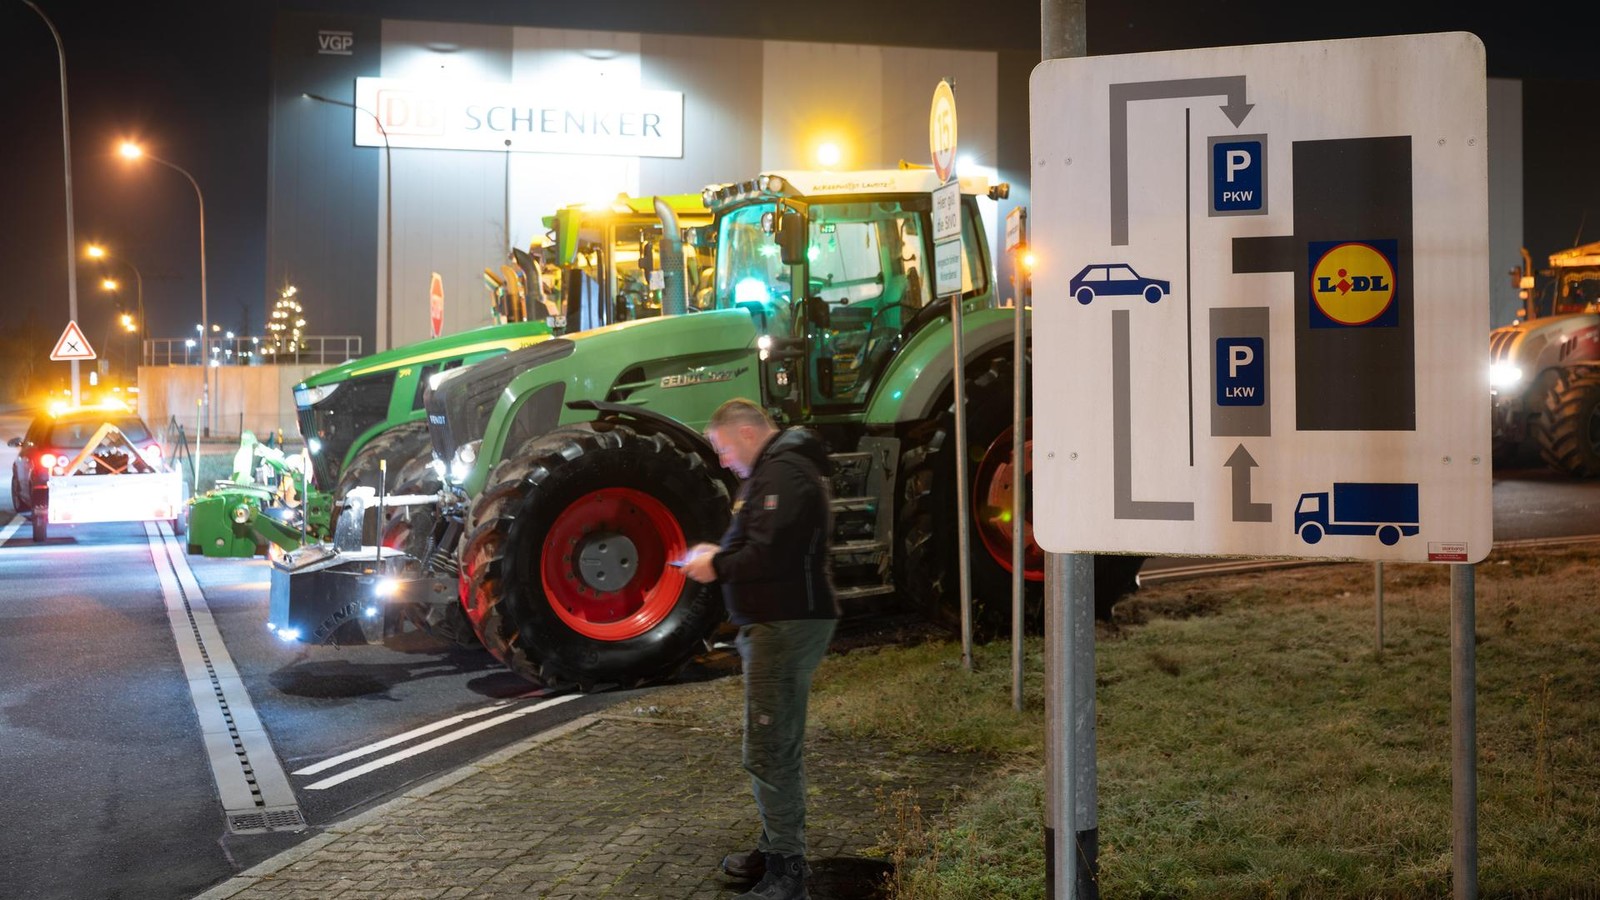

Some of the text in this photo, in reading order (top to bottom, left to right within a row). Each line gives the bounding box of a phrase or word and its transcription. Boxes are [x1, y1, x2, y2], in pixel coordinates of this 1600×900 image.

[319, 35, 353, 50] VGP
[386, 98, 662, 138] DB SCHENKER
[937, 110, 950, 154] 15
[1226, 150, 1251, 182] P
[1223, 191, 1253, 202] PKW
[1229, 345, 1254, 378] P
[661, 373, 703, 388] FENDT
[1226, 387, 1255, 397] LKW
